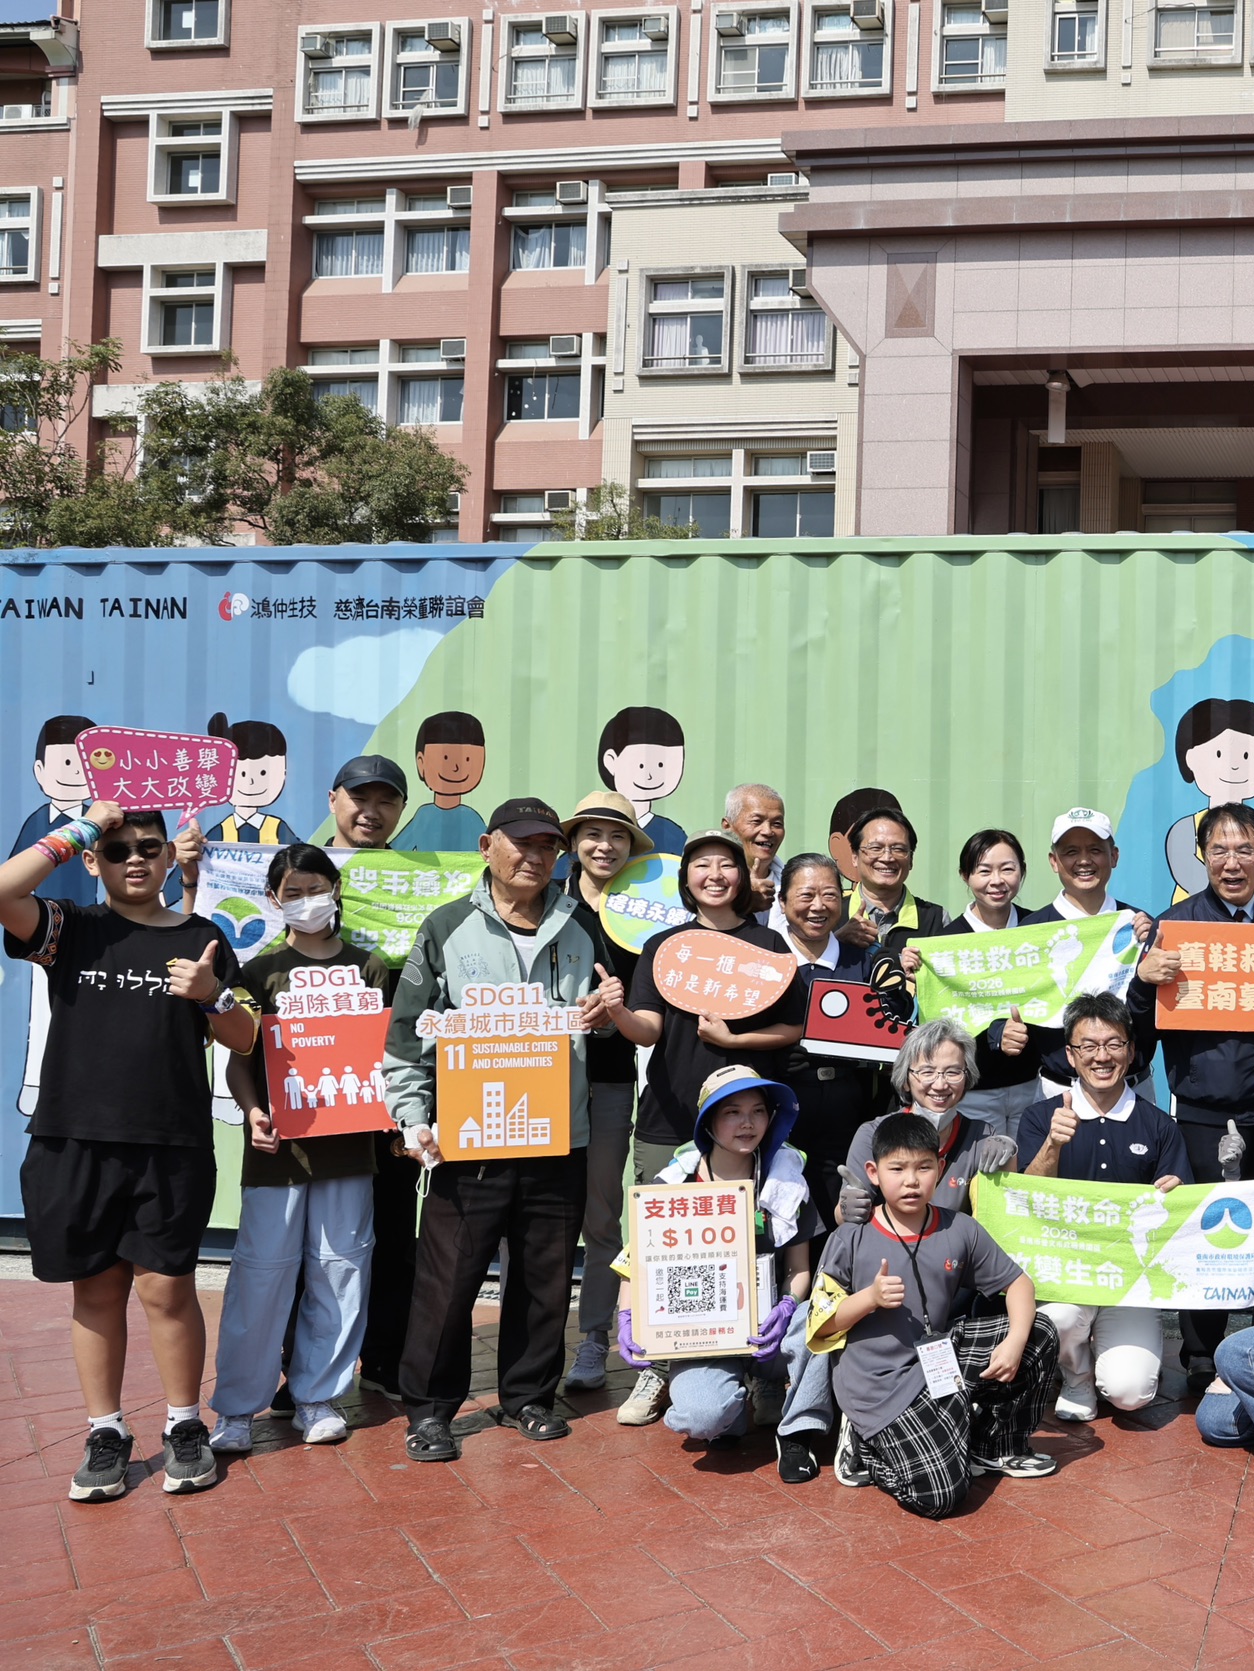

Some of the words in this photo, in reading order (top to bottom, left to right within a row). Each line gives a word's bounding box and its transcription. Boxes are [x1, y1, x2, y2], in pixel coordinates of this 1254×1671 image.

[0, 597, 84, 620] AIWAN
[100, 596, 187, 620] TAINAN
[250, 597, 317, 620] 鴻仲生技
[333, 595, 486, 621] 慈濟台南榮董聯誼會
[119, 748, 220, 772] 小小善舉
[113, 773, 218, 799] 大大改變
[350, 865, 472, 898] 改變生命
[396, 911, 425, 925] 026
[675, 943, 736, 975] 每一櫃
[929, 941, 1041, 977] 舊鞋救命
[293, 968, 361, 989] SDG1
[663, 968, 760, 1007] 都是新希望
[280, 991, 380, 1016] 消除貧窮
[464, 986, 544, 1007] SDG11
[420, 1009, 584, 1036] 永續城市與社區
[270, 1024, 283, 1050] 1
[289, 1023, 305, 1035] NO
[291, 1035, 336, 1049] POVERTY
[444, 1044, 467, 1071] 11
[472, 1041, 531, 1055] SUSTAINABLE
[531, 1041, 558, 1053] CITIES
[472, 1058, 491, 1070] AND
[493, 1056, 553, 1069] COMMUNITIES
[644, 1194, 737, 1220] 支持運費
[1003, 1187, 1122, 1227] 舊鞋救命
[662, 1225, 736, 1248] $100
[1041, 1225, 1078, 1241] 2026
[718, 1272, 727, 1312] 支持海運費
